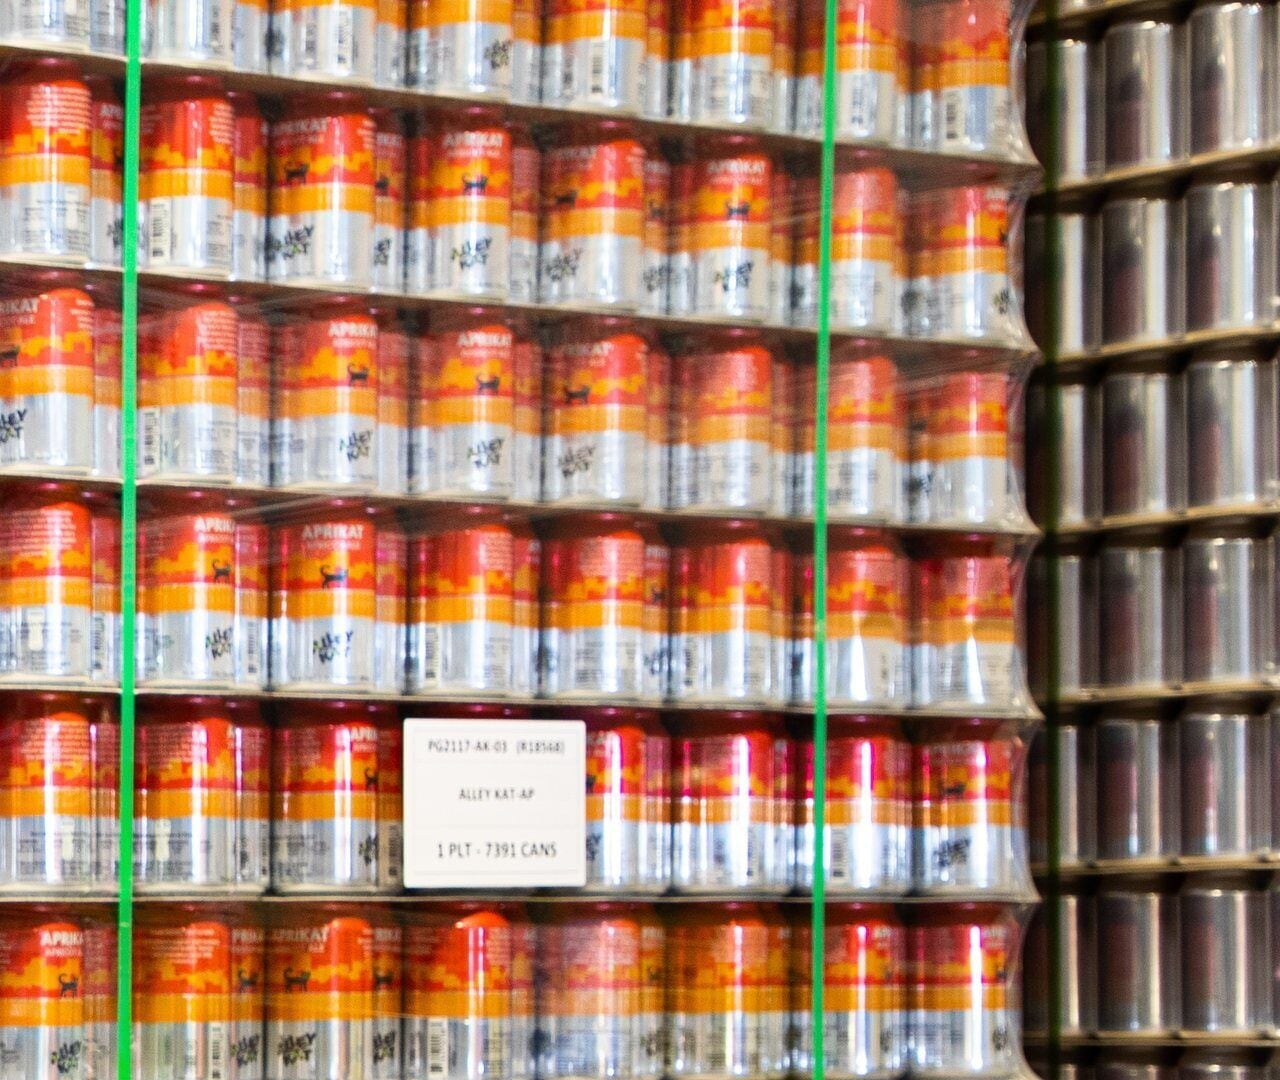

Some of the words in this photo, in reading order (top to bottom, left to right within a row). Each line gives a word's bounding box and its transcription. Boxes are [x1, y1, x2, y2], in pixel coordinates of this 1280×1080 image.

[301, 523, 365, 540] APRIKAT
[459, 788, 490, 801] ALLEY
[437, 843, 444, 859] 1
[448, 843, 472, 858] PLT
[485, 843, 517, 859] 7391
[521, 843, 558, 859] CANS
